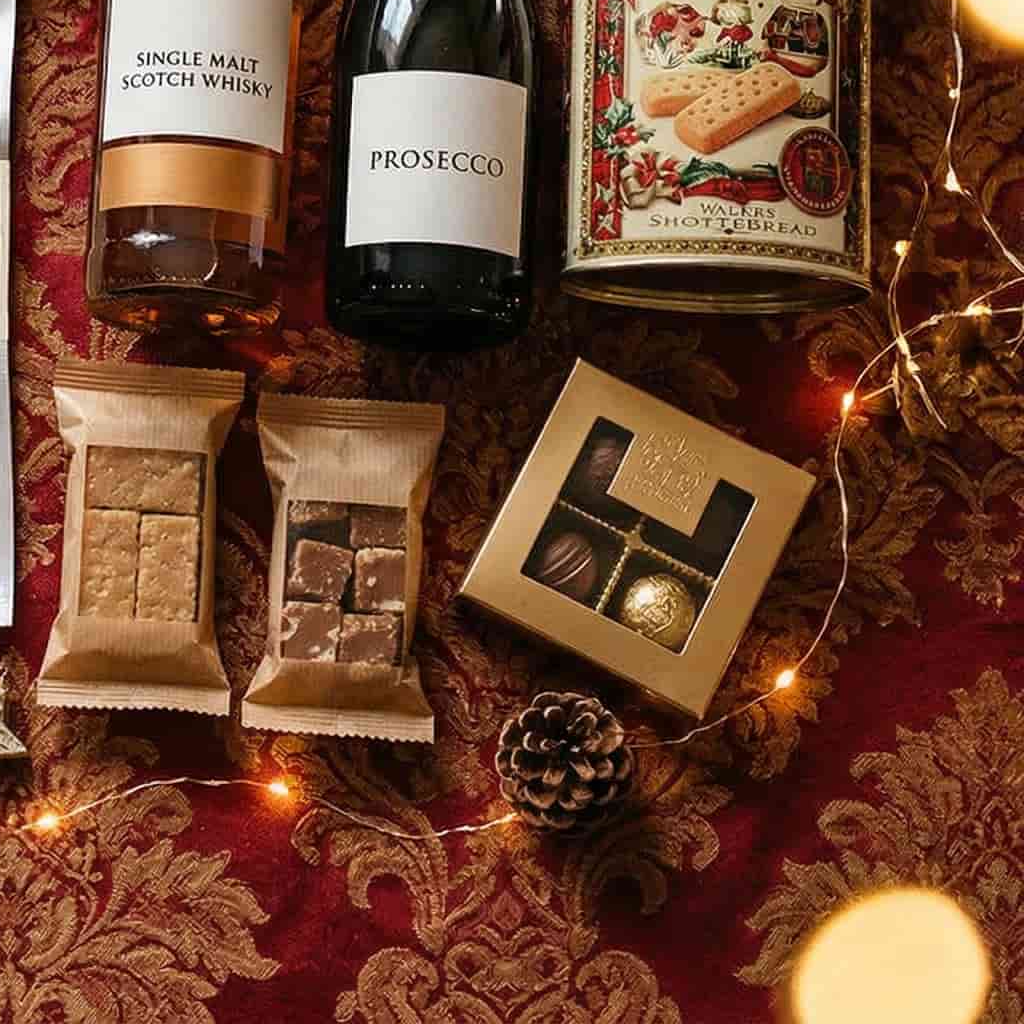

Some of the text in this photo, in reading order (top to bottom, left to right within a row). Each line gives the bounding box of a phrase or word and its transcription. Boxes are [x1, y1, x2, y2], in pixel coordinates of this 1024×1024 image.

[136, 50, 260, 75] SINGLE MALT
[121, 72, 273, 99] SCOTCH WHISKY
[369, 149, 504, 178] PROSECCO
